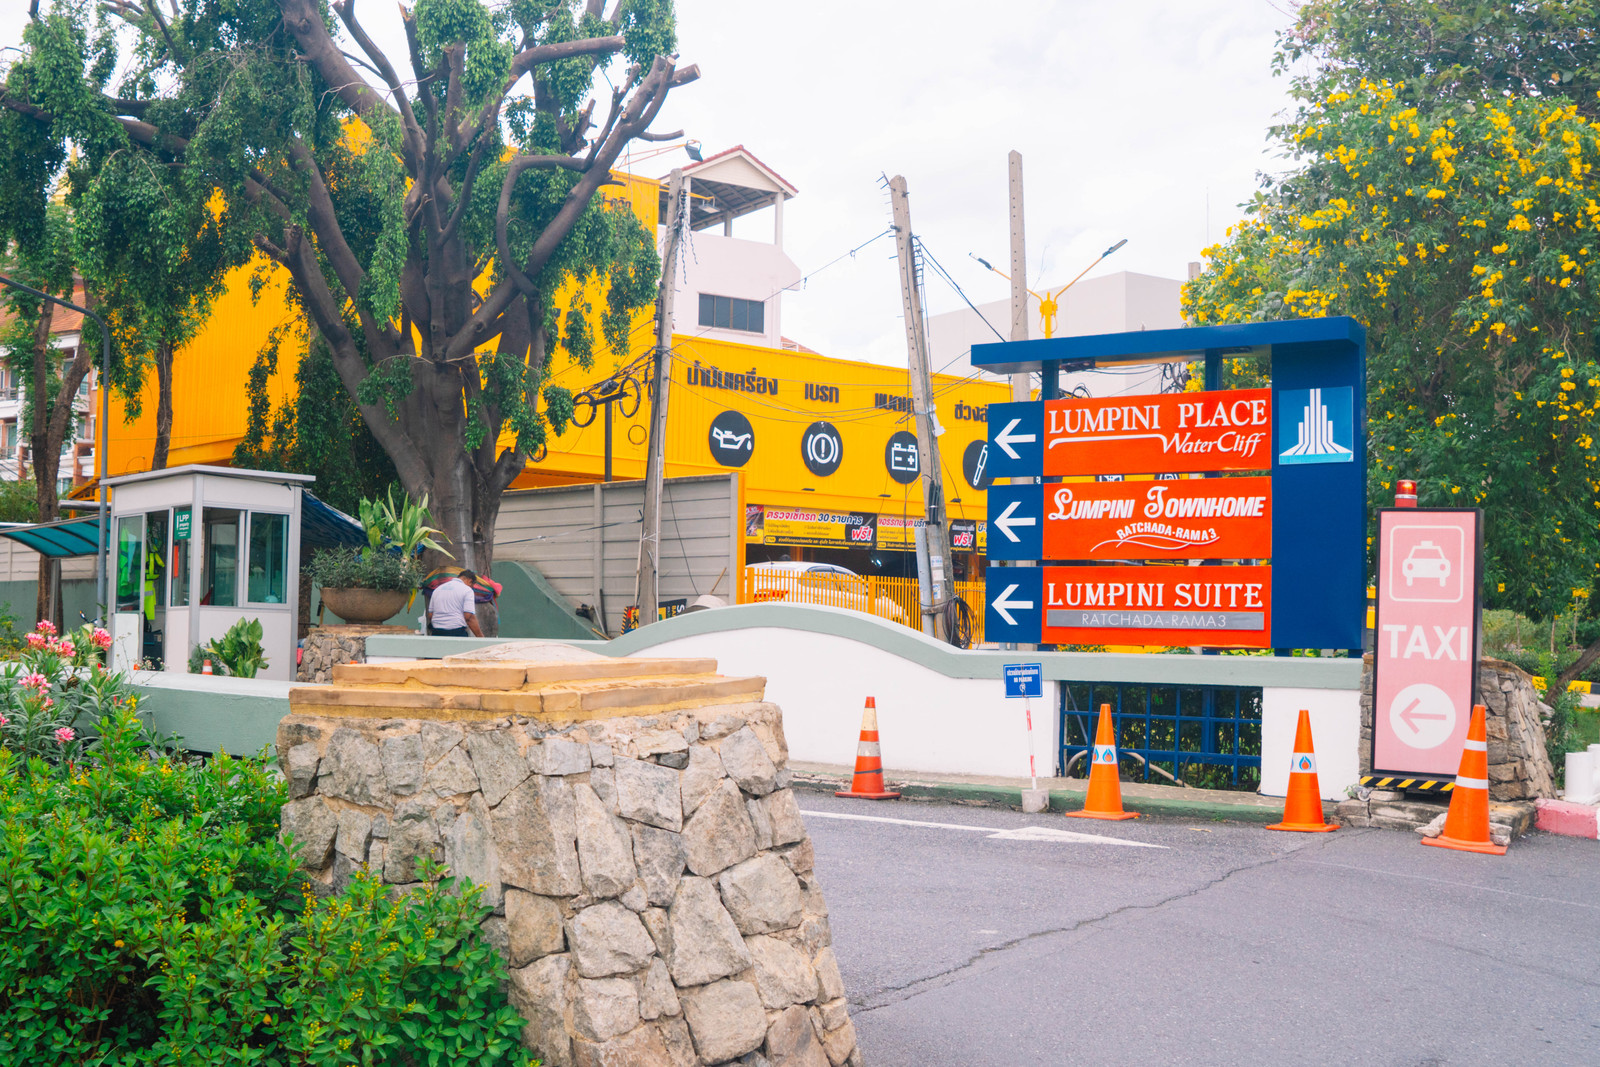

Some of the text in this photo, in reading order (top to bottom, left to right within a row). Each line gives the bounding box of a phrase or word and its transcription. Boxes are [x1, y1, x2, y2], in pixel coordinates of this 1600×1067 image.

[687, 360, 778, 396] น้ำมันเครื่อง
[804, 383, 840, 403] เบรก
[954, 400, 988, 423] ช่วงล่
[1049, 399, 1268, 434] LUMPINI PLACE
[1048, 485, 1266, 520] LUMPINI TOWNHOME
[179, 514, 189, 522] LPP
[818, 513, 829, 522] 30
[851, 525, 873, 541] ฟรี!
[953, 531, 974, 546] ฟรี!
[1047, 583, 1264, 608] LUMPINI SUITE
[1382, 624, 1469, 661] TAXI
